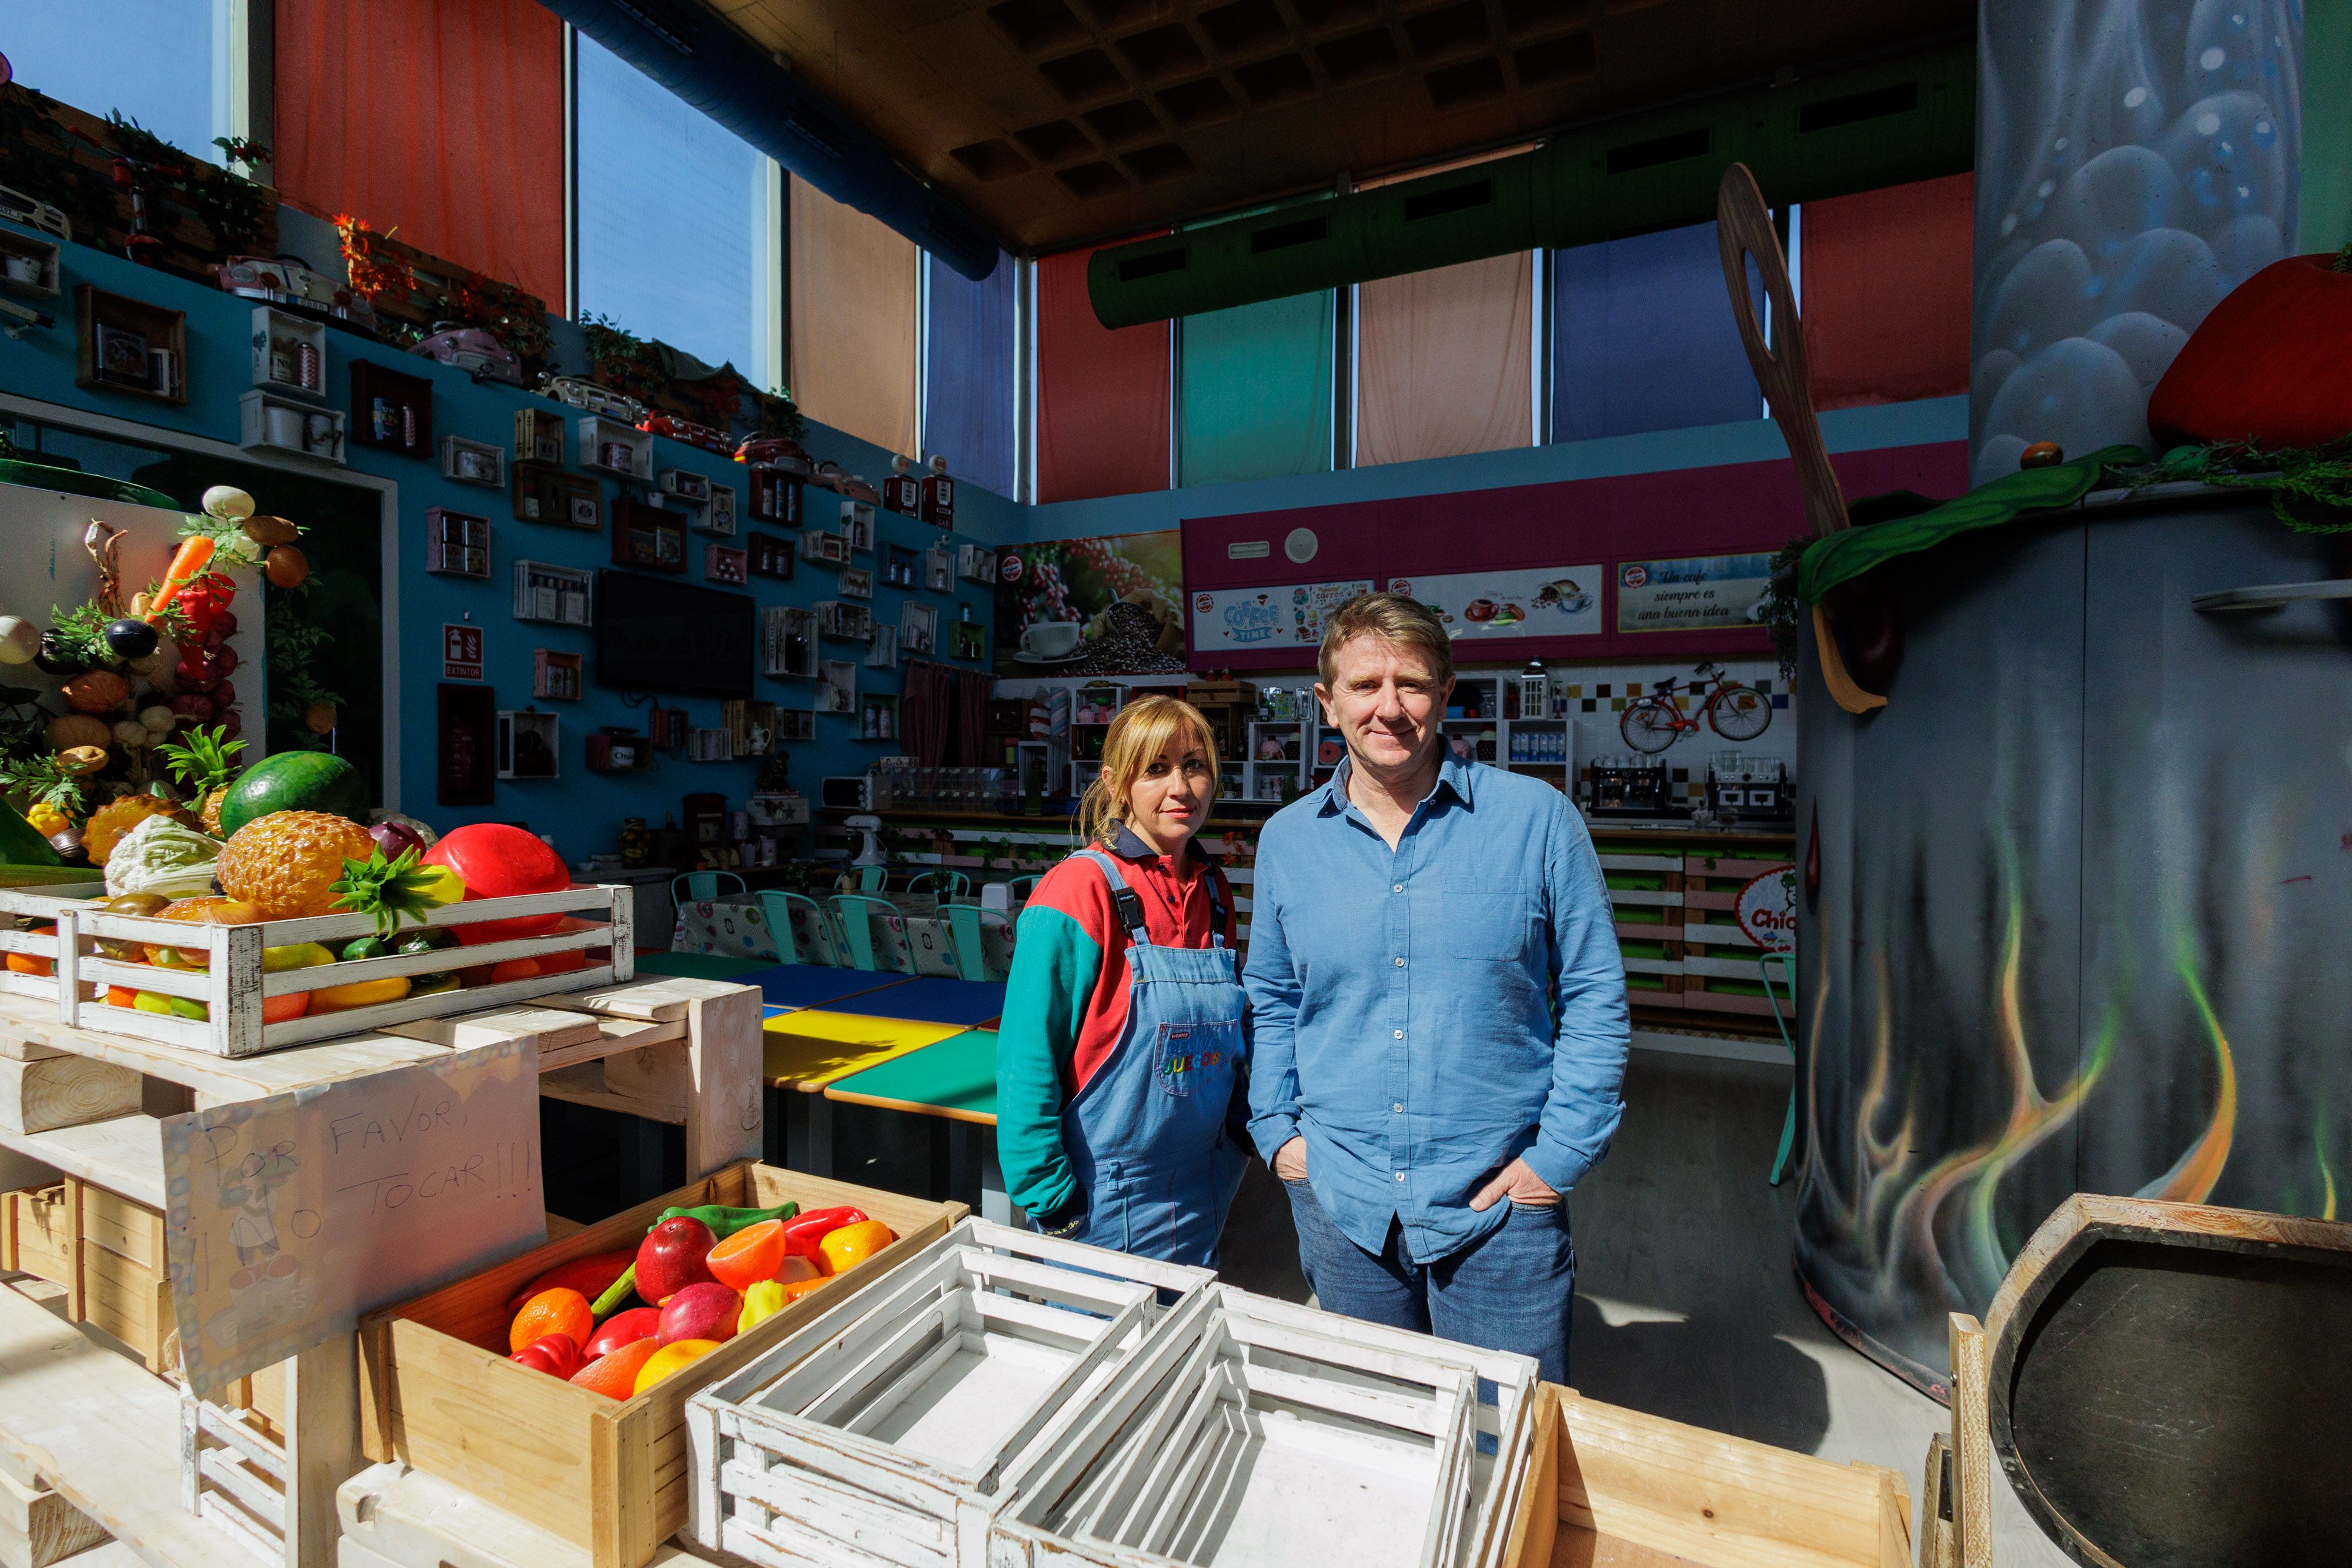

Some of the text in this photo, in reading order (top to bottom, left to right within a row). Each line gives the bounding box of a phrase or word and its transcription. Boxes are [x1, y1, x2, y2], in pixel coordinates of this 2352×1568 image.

[938, 519, 949, 527] GAS
[1660, 570, 1679, 583] Un
[1655, 590, 1715, 603] siempre es
[1638, 604, 1730, 620] una buena idea
[1240, 630, 1265, 640] TIME
[446, 665, 480, 677] EXTINTOR
[1168, 1037, 1218, 1056] PEQUE
[1164, 1051, 1222, 1075] JUEGOS
[204, 1095, 469, 1188] POR FAVOR,
[338, 1141, 533, 1216] TOCAR!!!
